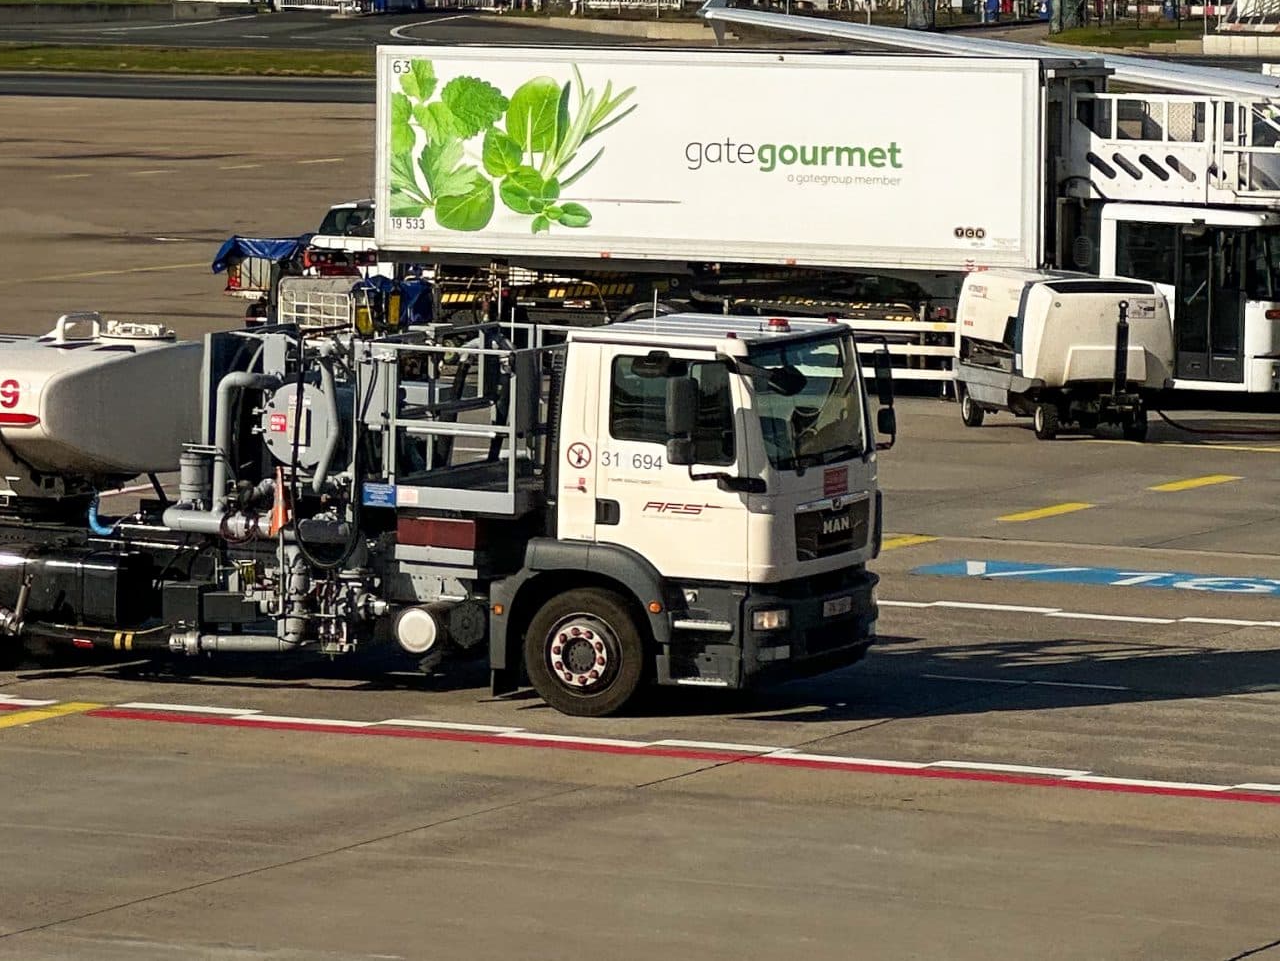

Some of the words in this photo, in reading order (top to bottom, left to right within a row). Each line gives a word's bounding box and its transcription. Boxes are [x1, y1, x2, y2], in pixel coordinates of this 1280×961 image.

[393, 60, 411, 74] 63
[796, 174, 853, 187] gategroup
[854, 175, 902, 187] member
[392, 219, 402, 230] 19
[406, 218, 426, 230] 533
[601, 450, 620, 467] 31
[632, 453, 663, 471] 694
[642, 501, 704, 515] AFS
[823, 516, 851, 535] MAN
